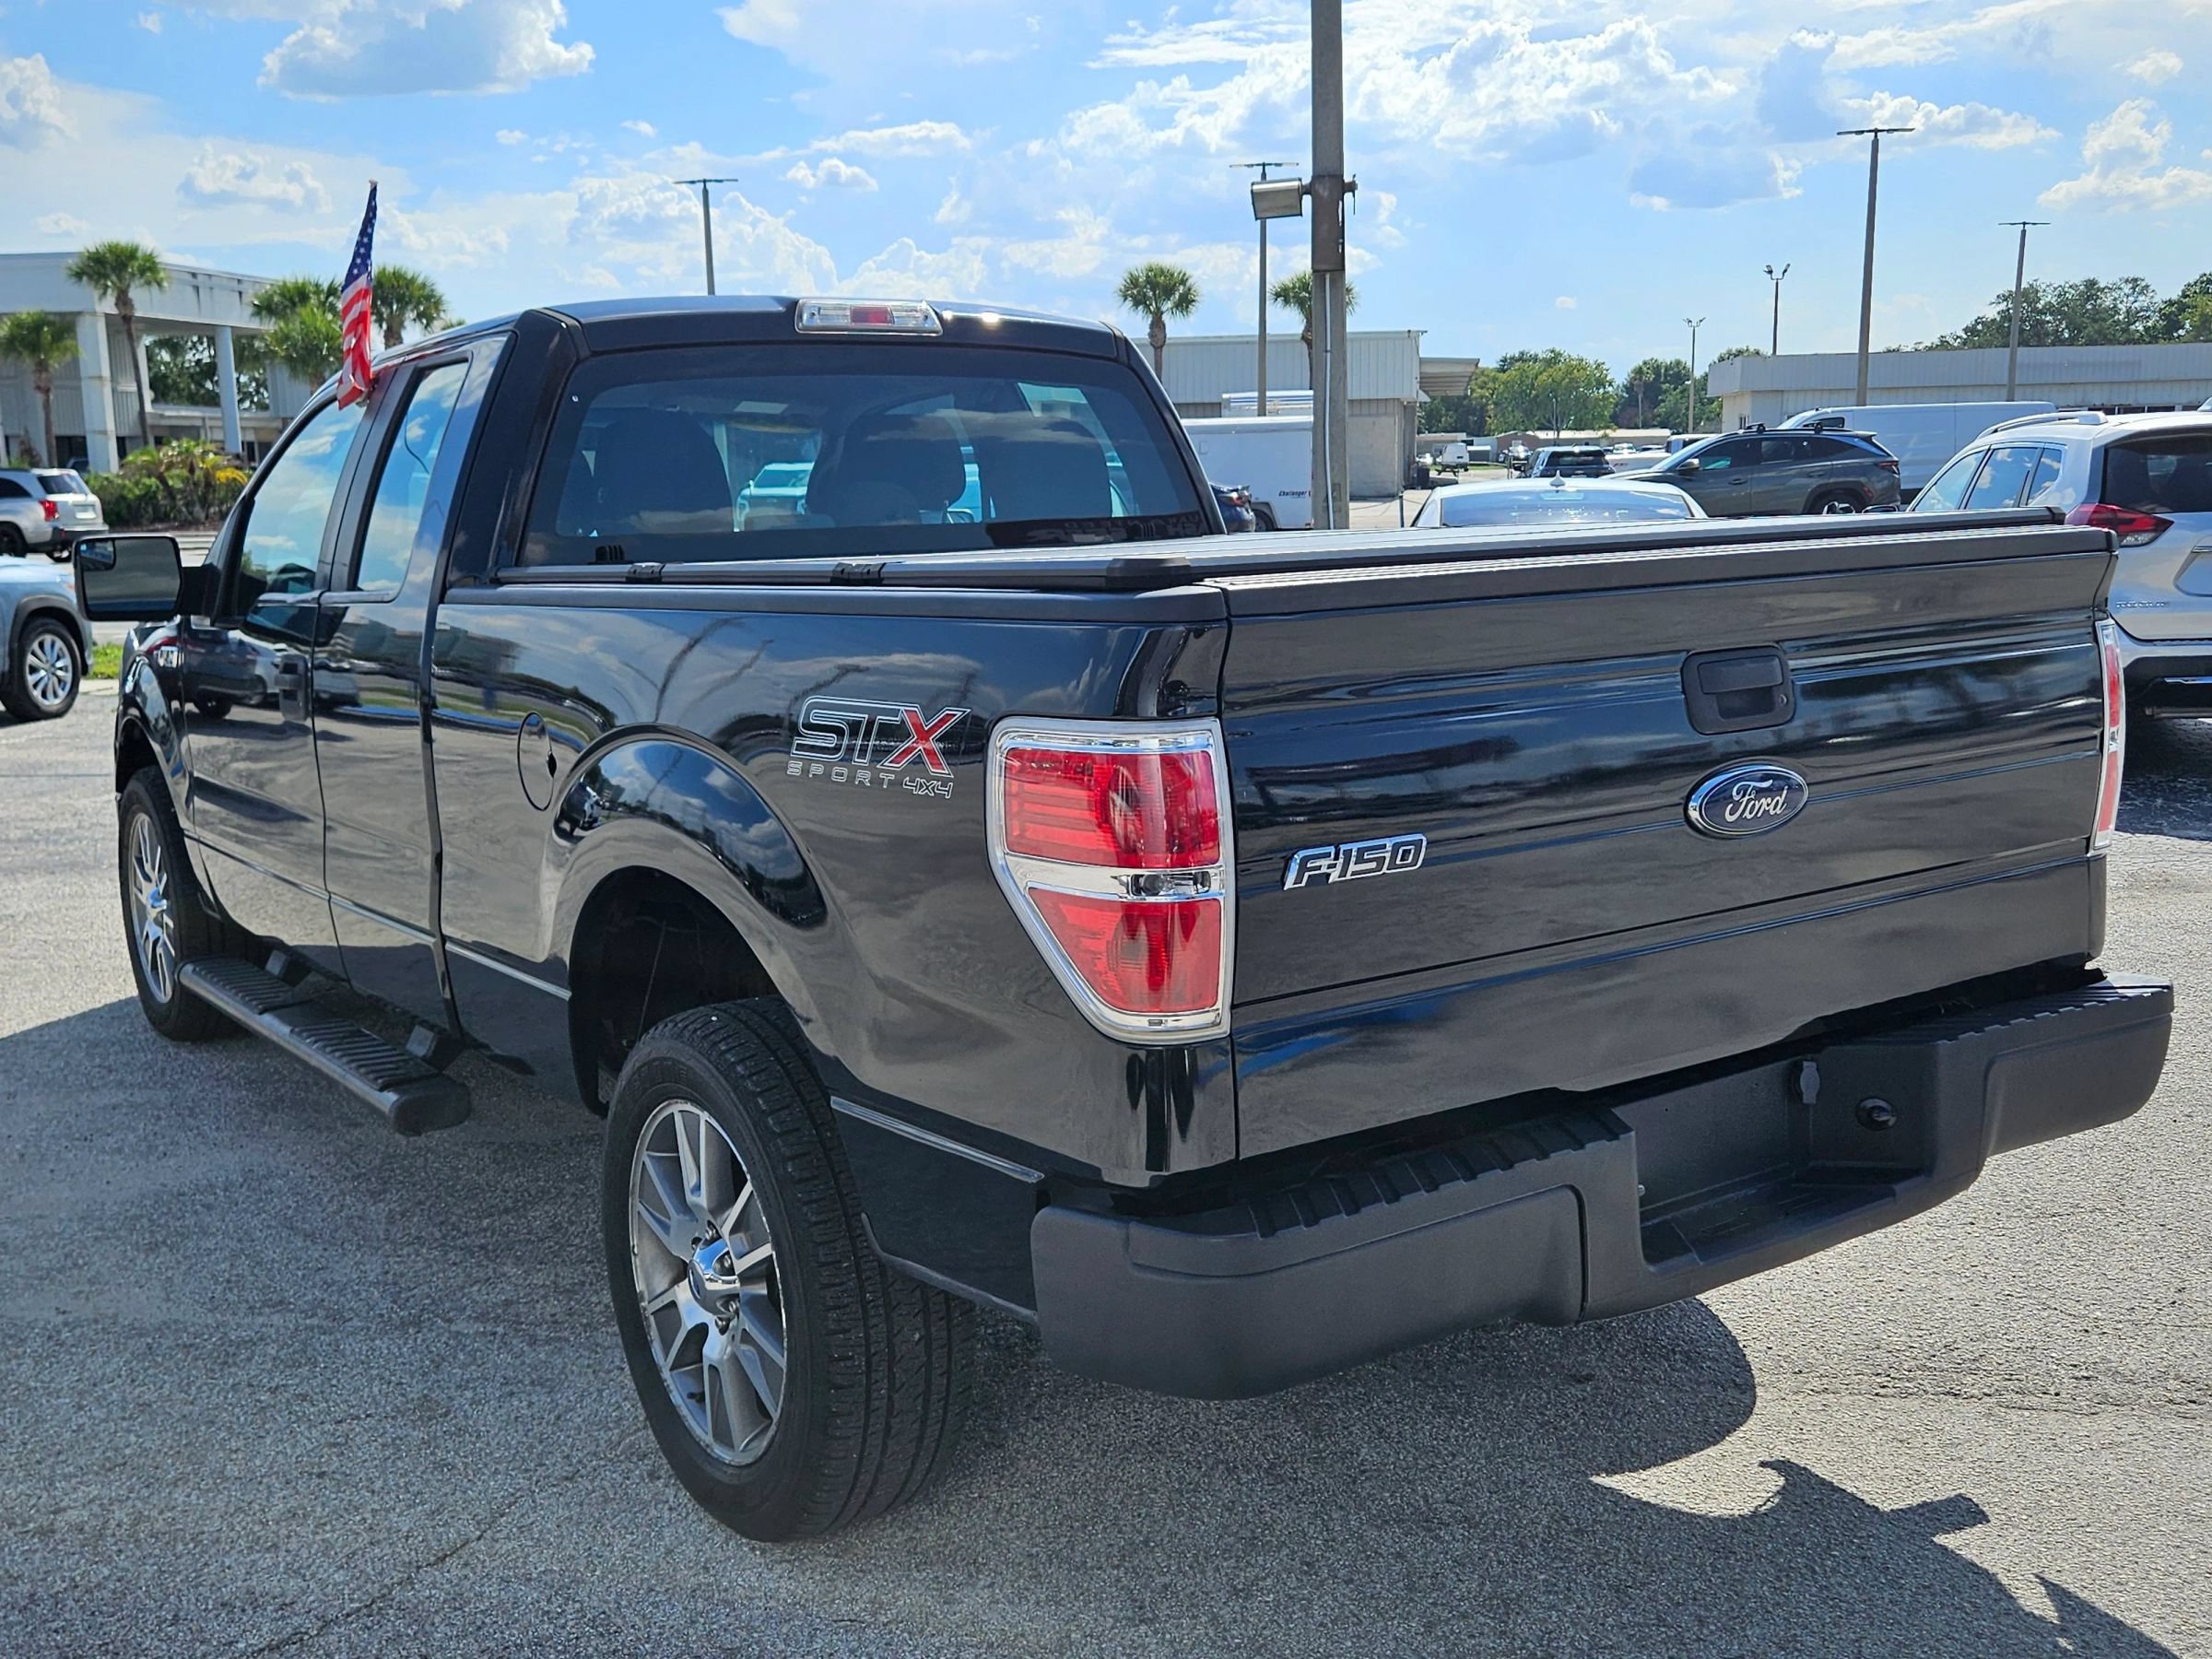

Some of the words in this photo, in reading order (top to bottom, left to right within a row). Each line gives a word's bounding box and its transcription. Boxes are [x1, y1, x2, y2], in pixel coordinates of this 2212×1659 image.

[791, 696, 971, 778] STX
[787, 760, 895, 789] SPORT
[1724, 779, 1789, 823] Ford
[1283, 832, 1428, 891] F-150
